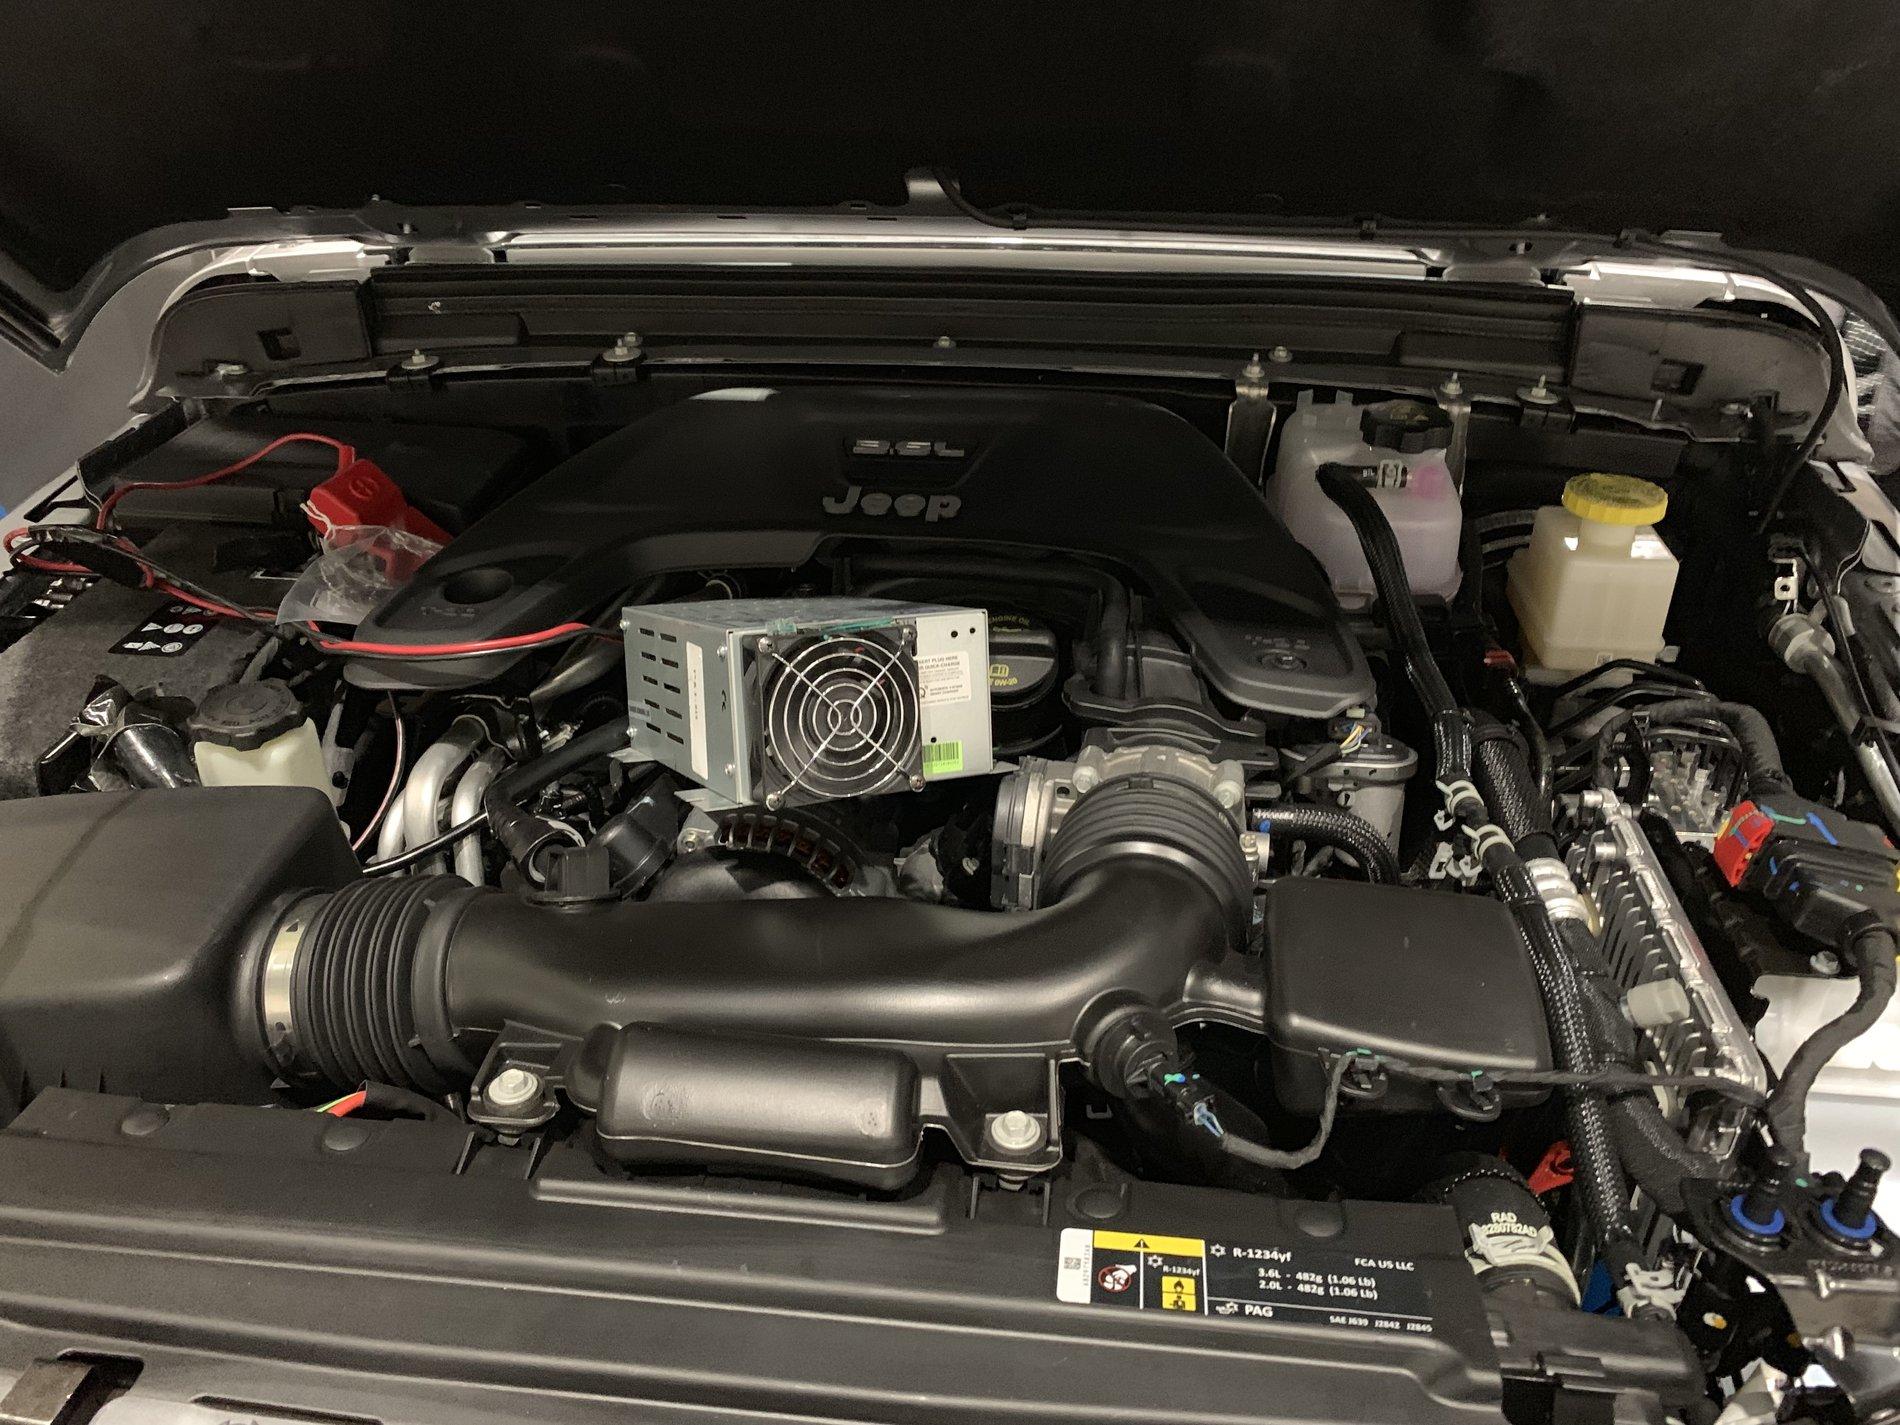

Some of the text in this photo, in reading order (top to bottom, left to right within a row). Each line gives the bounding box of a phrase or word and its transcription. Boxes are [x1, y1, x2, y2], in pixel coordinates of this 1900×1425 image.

[822, 486, 962, 522] Jeep
[1490, 1212, 1518, 1223] RAD
[1232, 1247, 1292, 1263] R-1234yf
[1162, 1264, 1200, 1277] R-1234yf
[1354, 1257, 1415, 1272] FCA US LLC
[1258, 1267, 1281, 1279] 3.6L
[1295, 1271, 1323, 1284] 482g
[1327, 1273, 1356, 1286] (1.06
[1357, 1276, 1376, 1289] Lb)
[1259, 1280, 1283, 1290] 2.0L
[1297, 1283, 1325, 1296] 482g
[1329, 1285, 1358, 1298] (1.06
[1360, 1288, 1378, 1301] Lb)
[1244, 1304, 1274, 1318] PAG
[1329, 1315, 1347, 1325] SAE
[1348, 1316, 1369, 1327] J639
[1374, 1319, 1401, 1330] J2842
